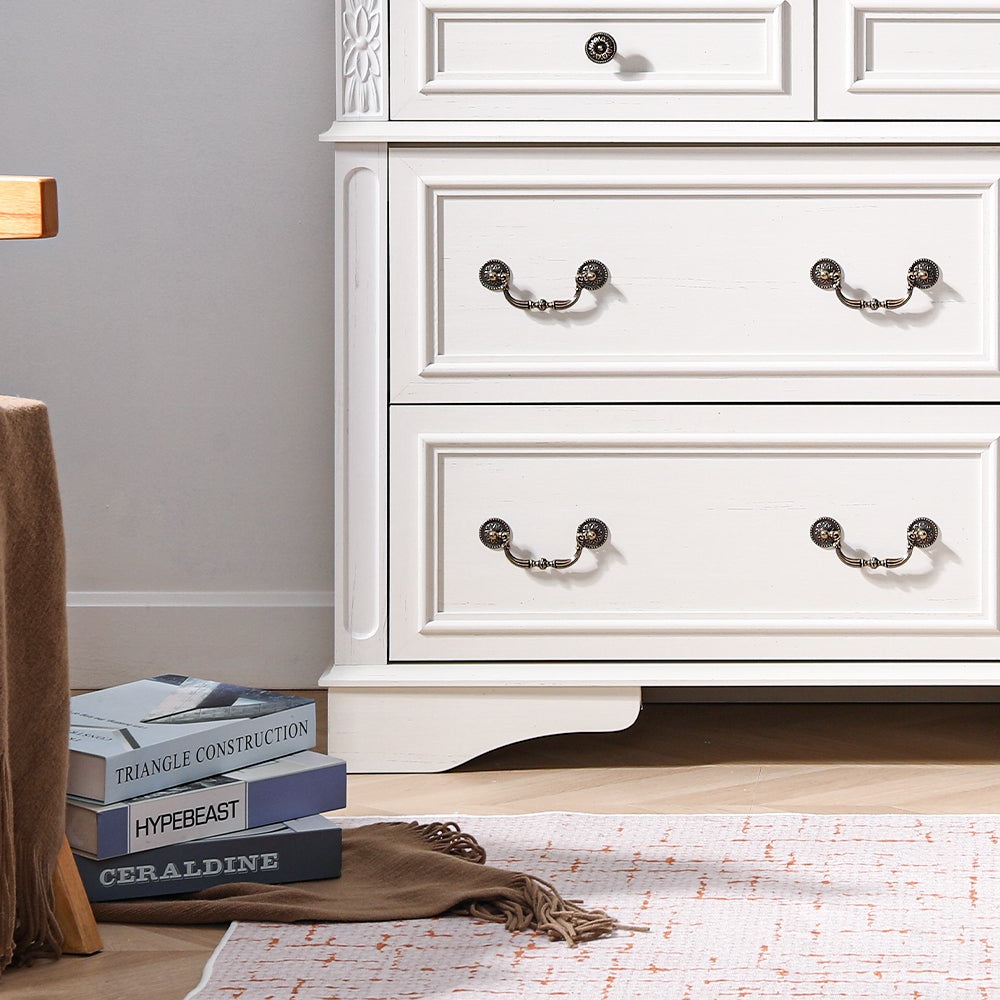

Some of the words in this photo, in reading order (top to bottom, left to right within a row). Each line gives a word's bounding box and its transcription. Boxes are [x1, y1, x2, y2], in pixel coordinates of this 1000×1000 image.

[115, 750, 191, 784] TRIANGLE
[196, 719, 309, 763] CONSTRUCTION
[135, 800, 239, 838] HYPEBEAST
[99, 852, 279, 886] CERALDINE
